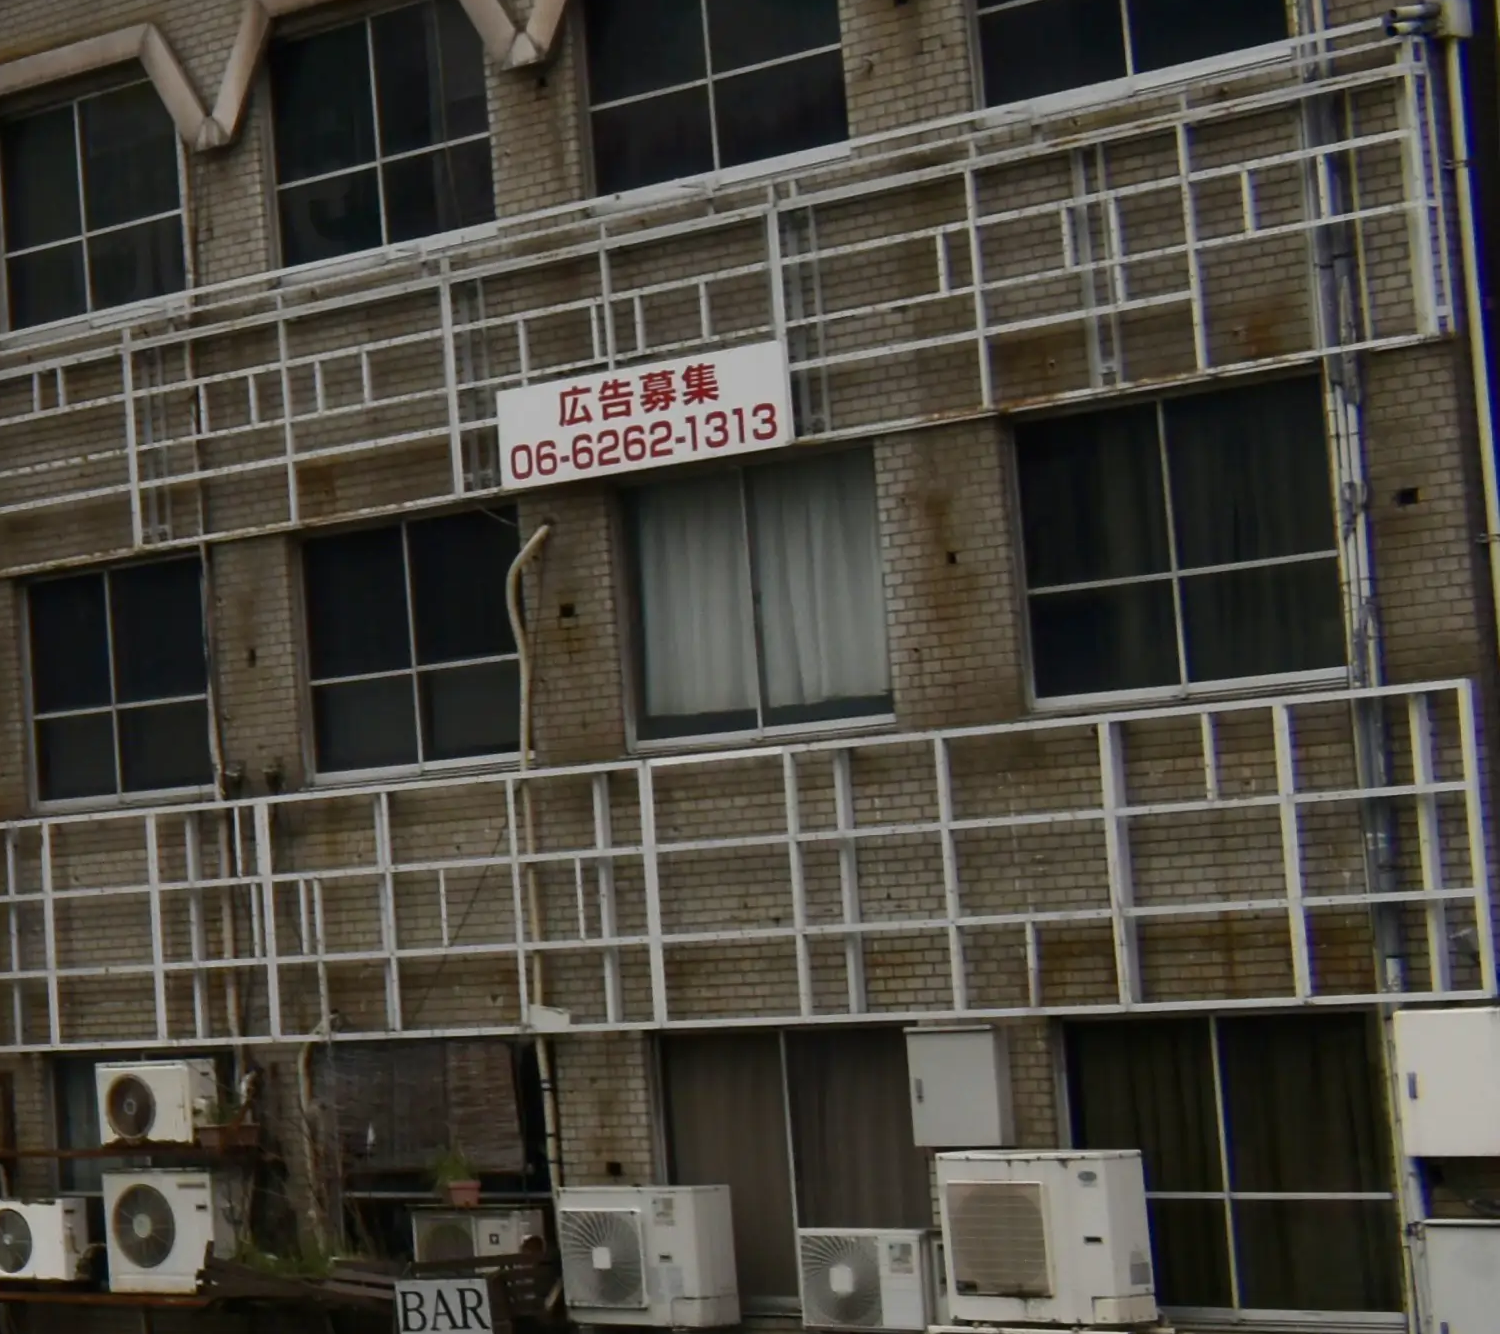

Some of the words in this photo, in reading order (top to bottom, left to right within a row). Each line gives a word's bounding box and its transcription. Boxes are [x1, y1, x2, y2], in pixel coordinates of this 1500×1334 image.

[557, 361, 720, 428] 広告募集
[508, 402, 781, 482] 06-6262-1313
[399, 1288, 490, 1334] BAR
